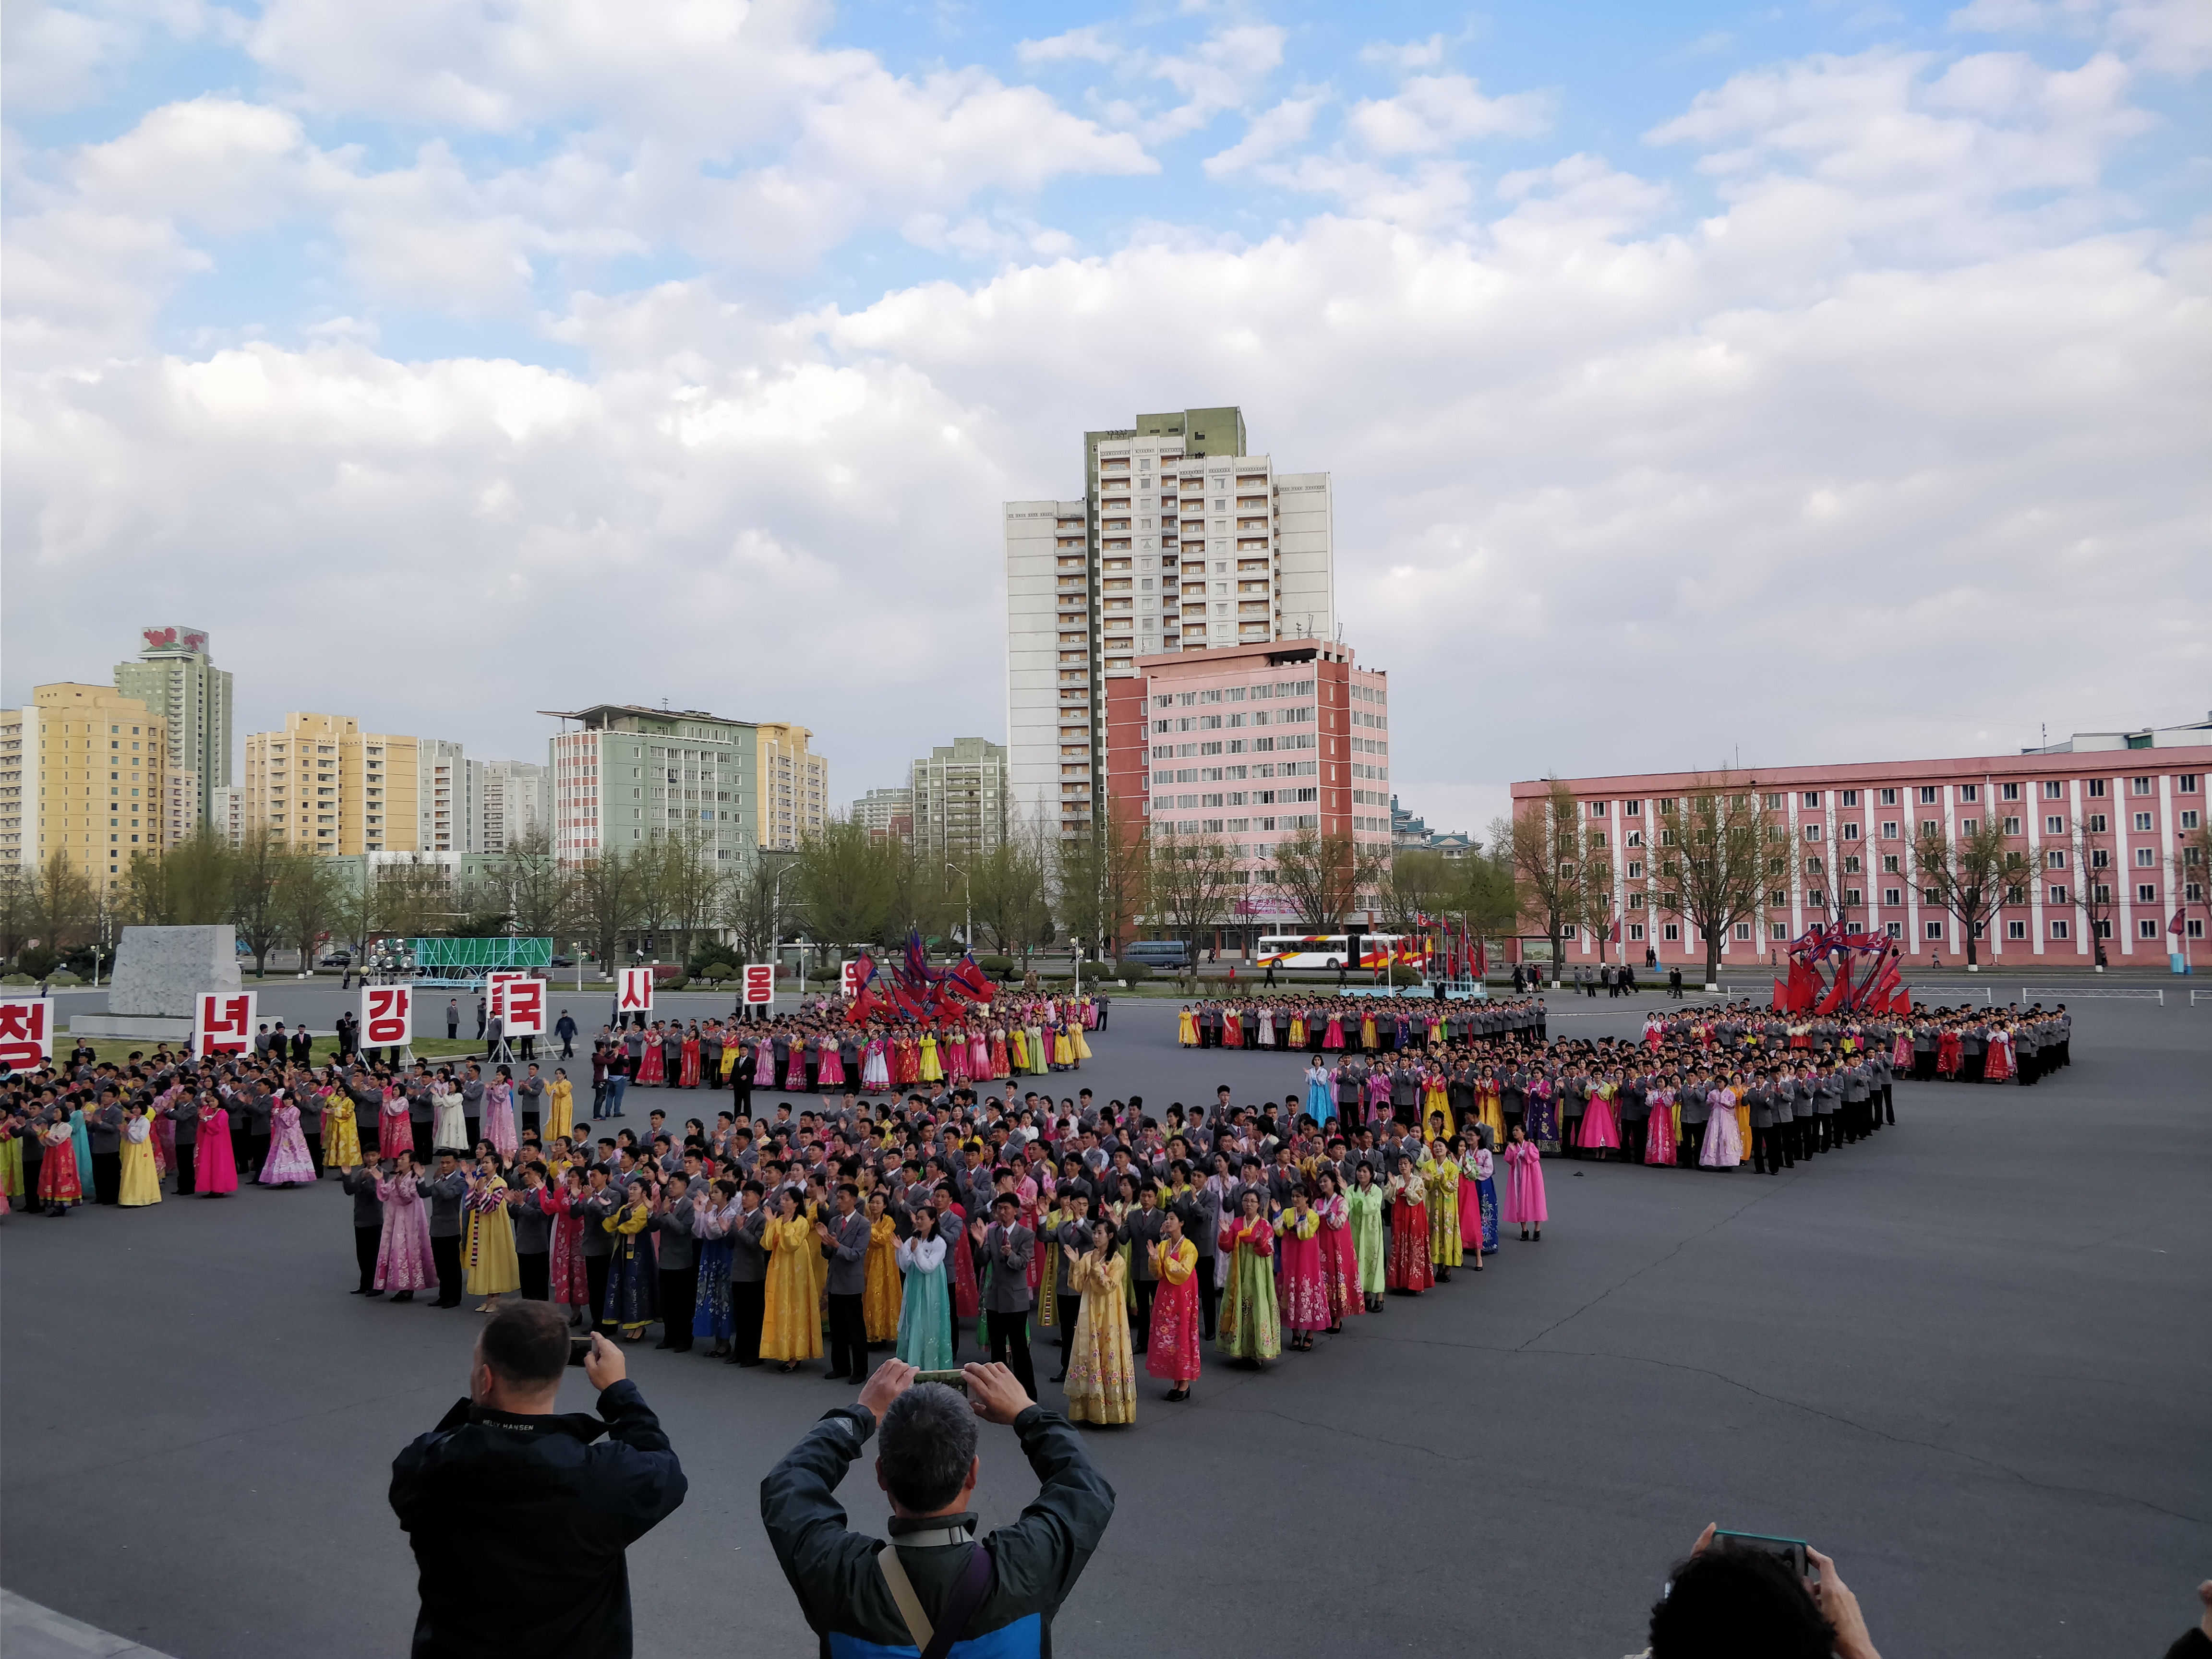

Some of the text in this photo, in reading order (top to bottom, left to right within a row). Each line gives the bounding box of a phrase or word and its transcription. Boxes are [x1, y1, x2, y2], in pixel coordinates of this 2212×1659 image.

[511, 983, 541, 1030] 국
[622, 971, 651, 1009] 사
[748, 967, 770, 1002] 옹
[0, 1004, 44, 1069] 청
[204, 996, 249, 1055] 년
[369, 990, 408, 1042] 강
